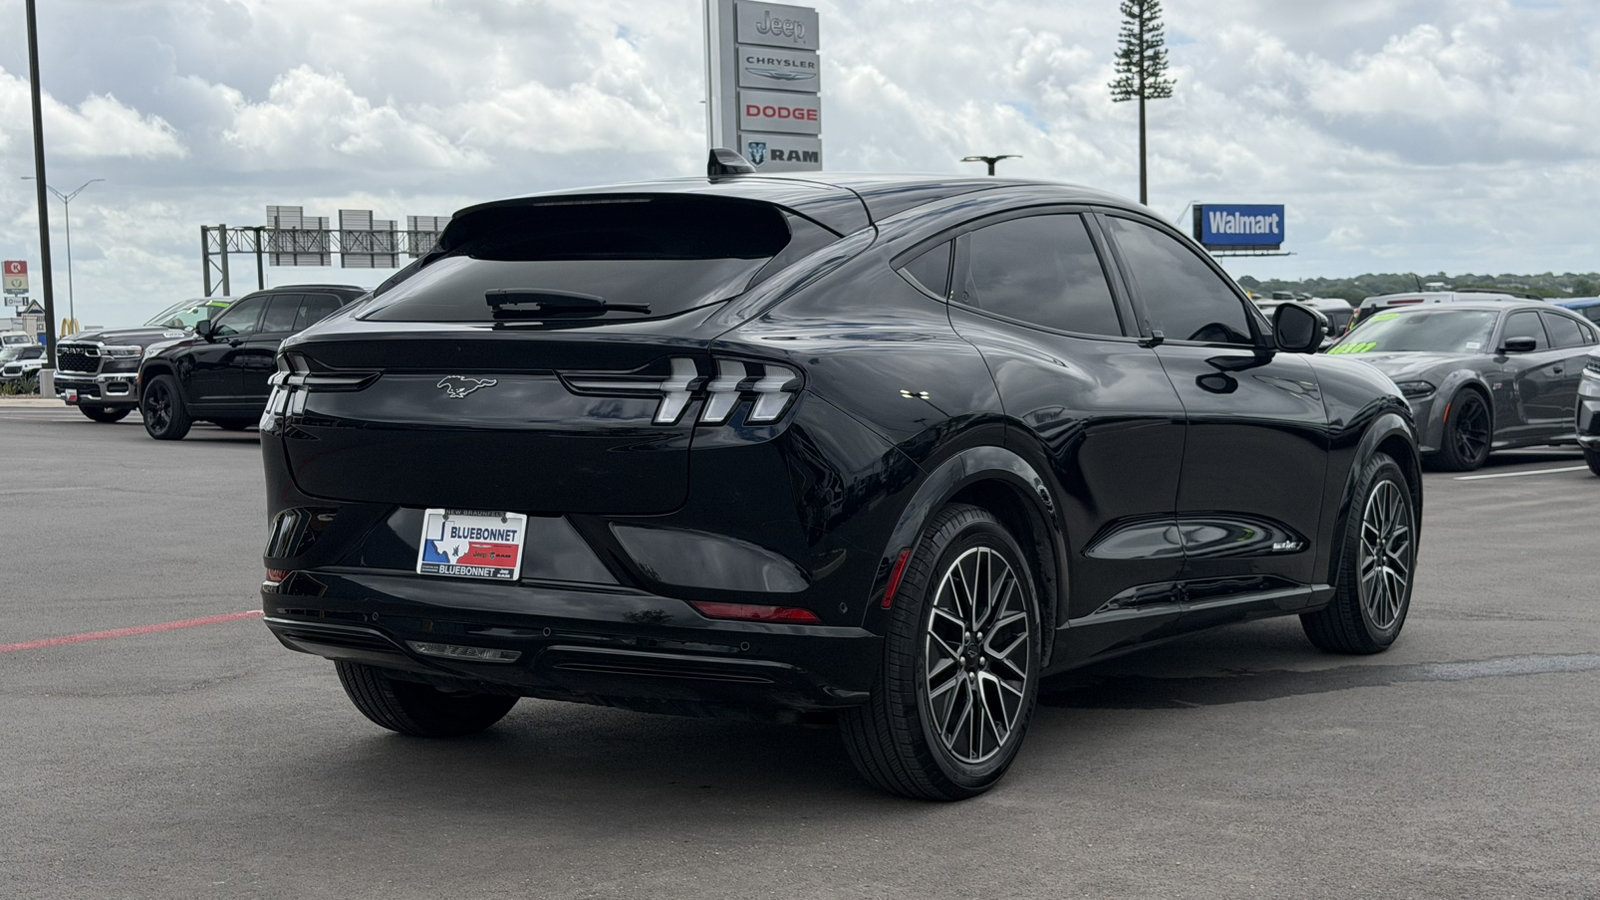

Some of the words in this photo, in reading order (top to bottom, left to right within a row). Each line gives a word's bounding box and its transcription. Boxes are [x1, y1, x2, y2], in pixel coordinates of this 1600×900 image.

[756, 10, 806, 43] Jeep
[746, 56, 815, 69] CHRYSLER
[746, 104, 818, 121] DODGE
[771, 149, 819, 163] RAM
[1209, 211, 1279, 234] Walmart
[450, 526, 517, 542] BLUEBONNET
[439, 565, 495, 577] BLUEBONNET
